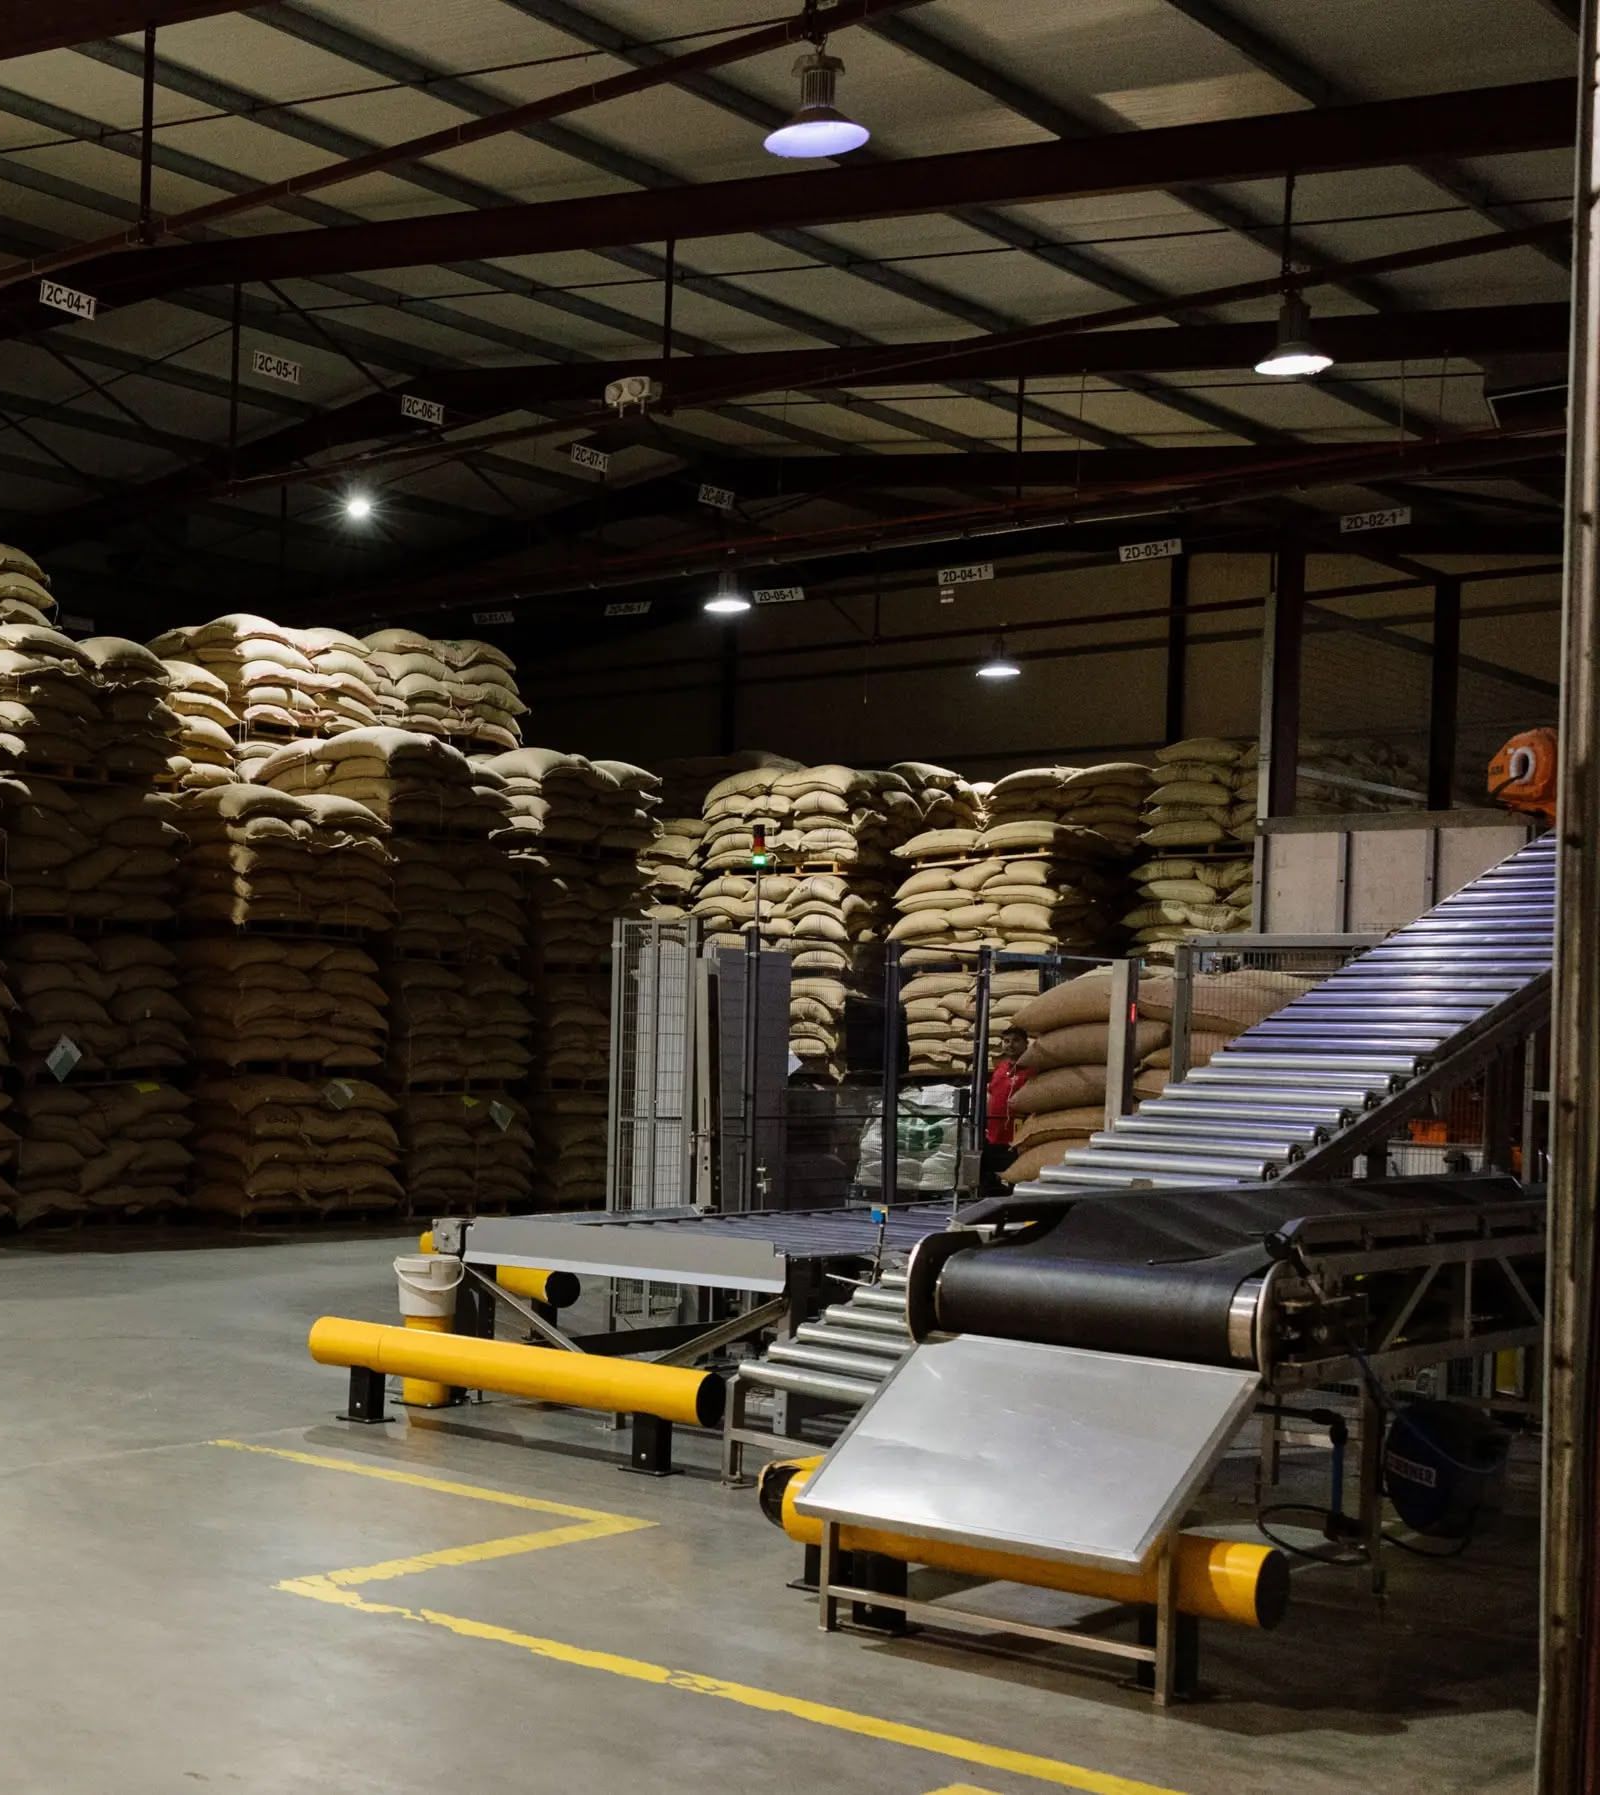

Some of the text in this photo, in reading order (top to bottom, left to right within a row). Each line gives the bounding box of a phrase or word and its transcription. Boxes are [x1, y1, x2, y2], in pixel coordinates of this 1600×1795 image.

[46, 284, 92, 316] 2C-04-1
[258, 354, 298, 382] 2C-05-1
[406, 398, 441, 421] 2C-06-1
[575, 447, 606, 470] 2C-07-1
[1346, 511, 1396, 530] 2D-02-1
[1125, 542, 1169, 559] 2D-03-1
[943, 567, 982, 583] 2D-04-1
[758, 589, 794, 602] 2D-05-1
